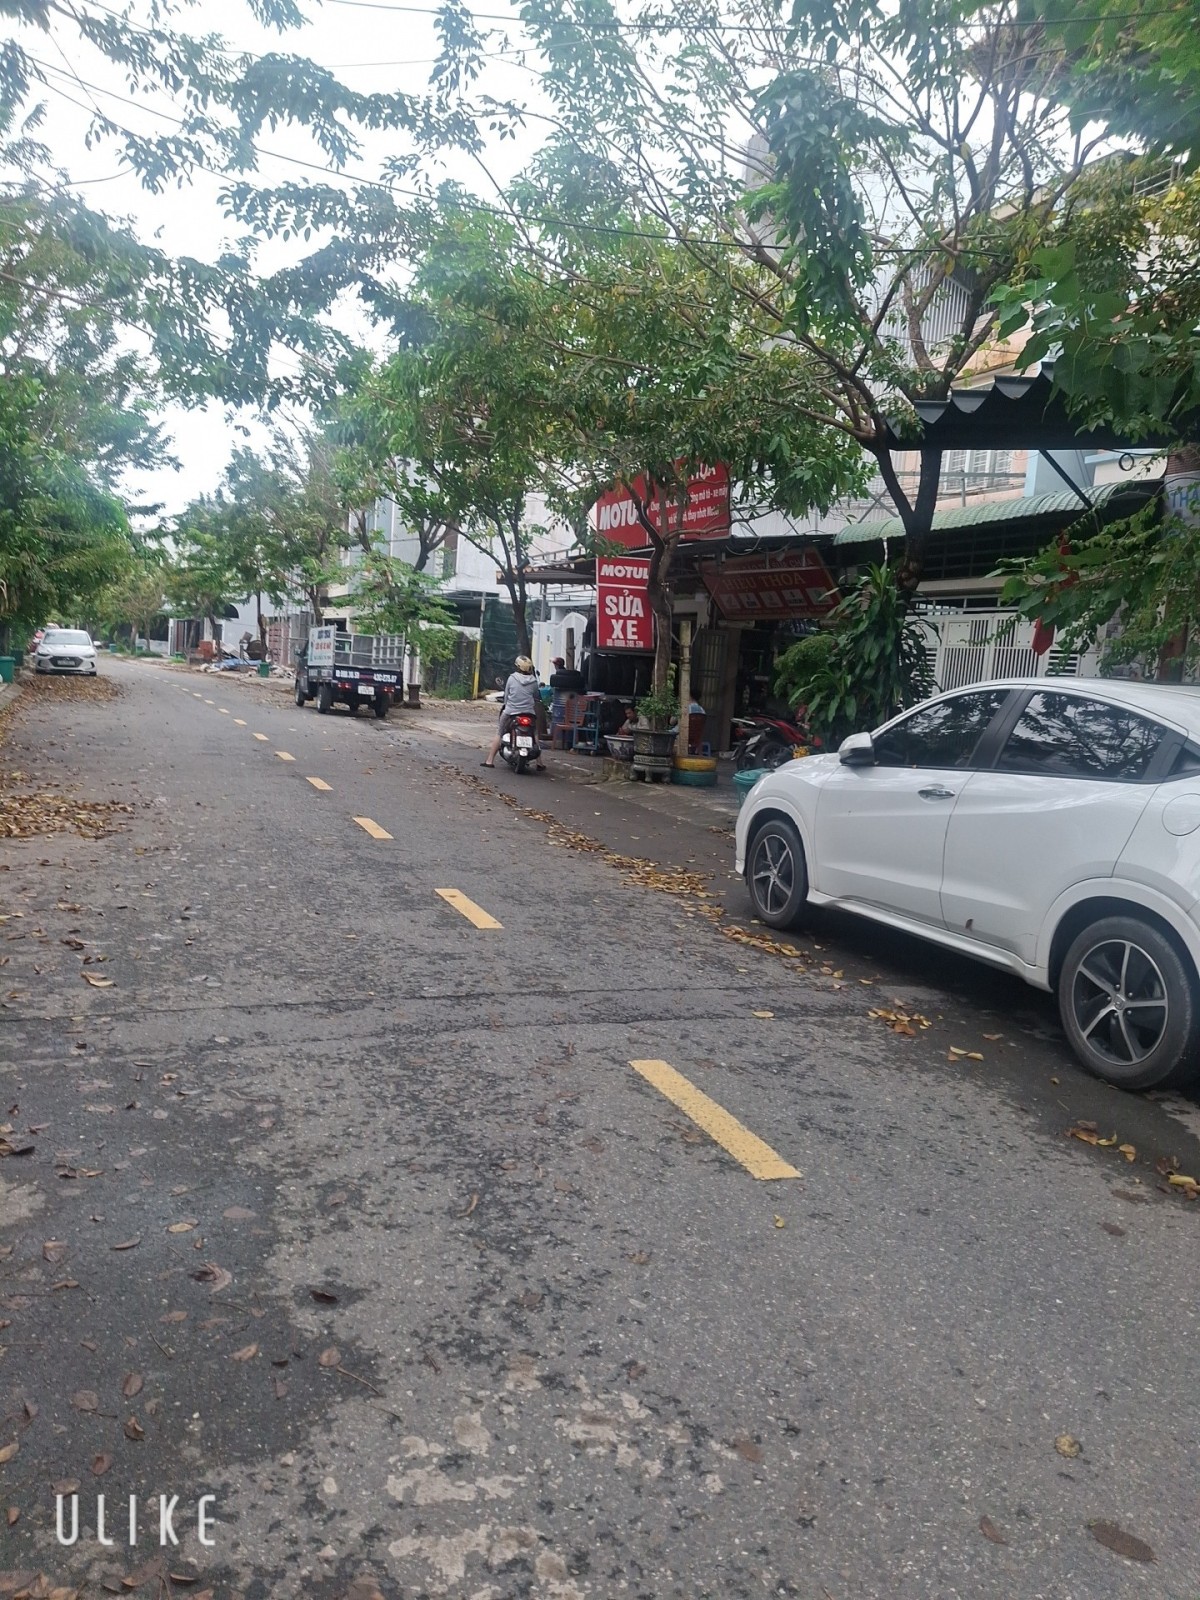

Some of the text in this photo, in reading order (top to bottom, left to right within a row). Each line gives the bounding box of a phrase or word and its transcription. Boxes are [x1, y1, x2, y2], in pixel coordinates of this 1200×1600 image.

[599, 499, 640, 531] MOTU
[600, 564, 649, 579] MOTUL
[605, 589, 644, 617] SỬA
[611, 619, 638, 640] XE
